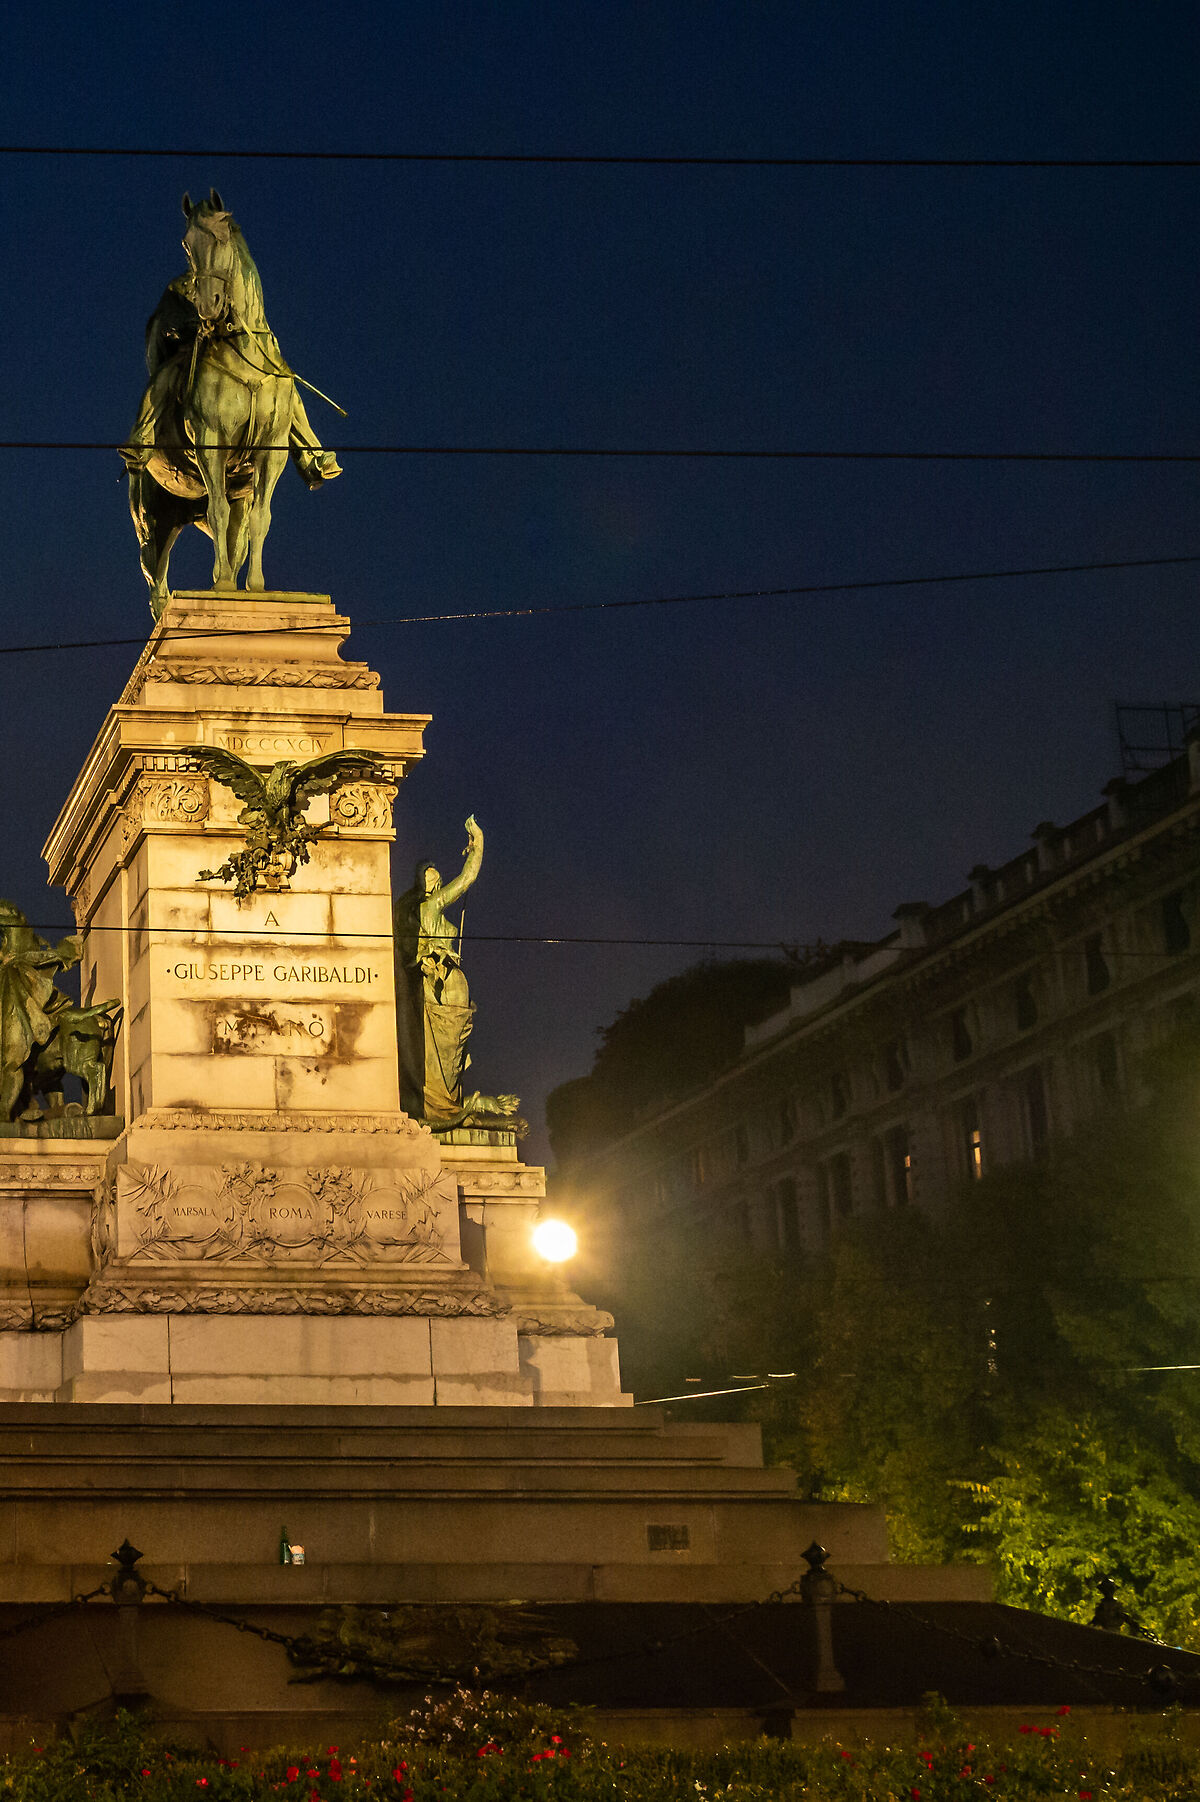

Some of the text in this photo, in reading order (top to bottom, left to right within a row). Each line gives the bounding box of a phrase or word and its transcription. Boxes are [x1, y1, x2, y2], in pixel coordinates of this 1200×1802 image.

[217, 736, 328, 753] MDCCCXCIV
[264, 910, 280, 927] A
[173, 963, 372, 984] GIUSEPPE GARIBALDI
[171, 1207, 216, 1217] MARSALA
[269, 1207, 313, 1220] ROMA
[366, 1209, 408, 1221] VARESE
